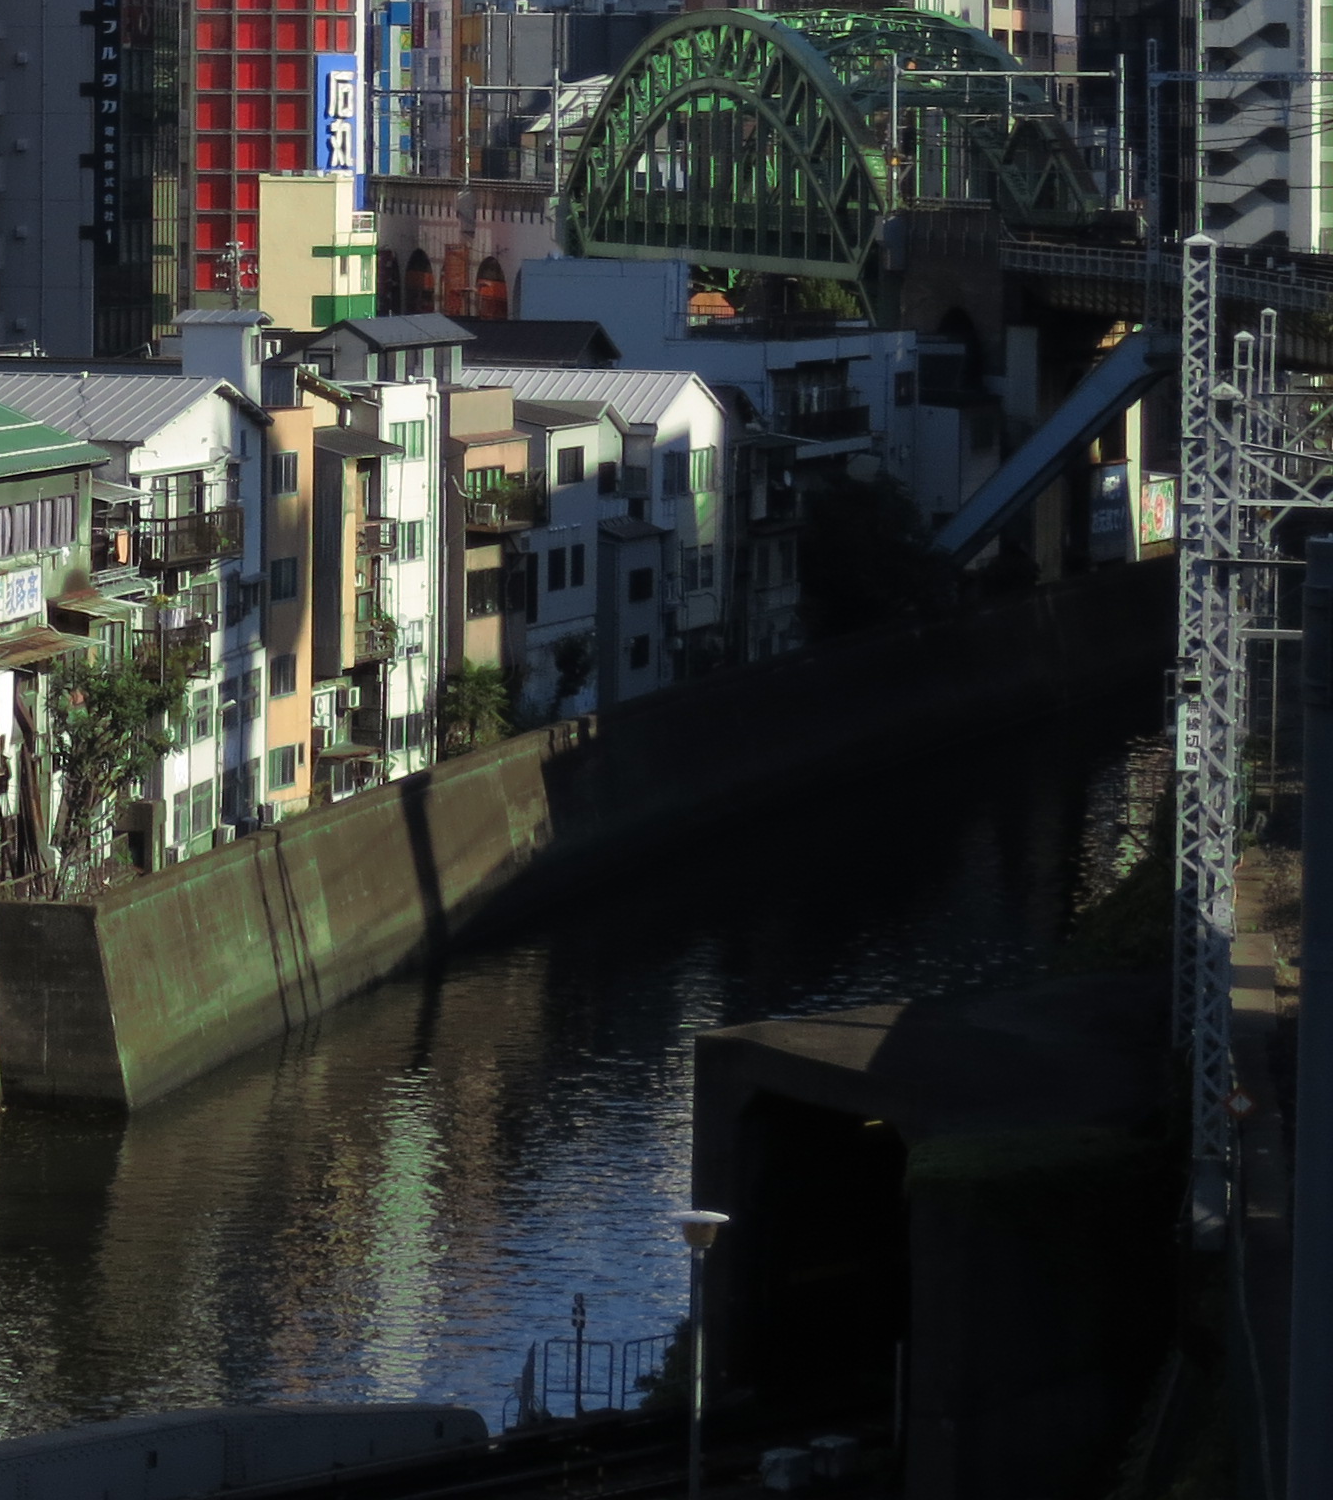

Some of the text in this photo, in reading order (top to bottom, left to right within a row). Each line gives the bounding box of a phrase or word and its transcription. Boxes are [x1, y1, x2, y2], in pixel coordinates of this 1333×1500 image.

[328, 70, 354, 176] 石丸
[1185, 701, 1201, 766] 無線切替
